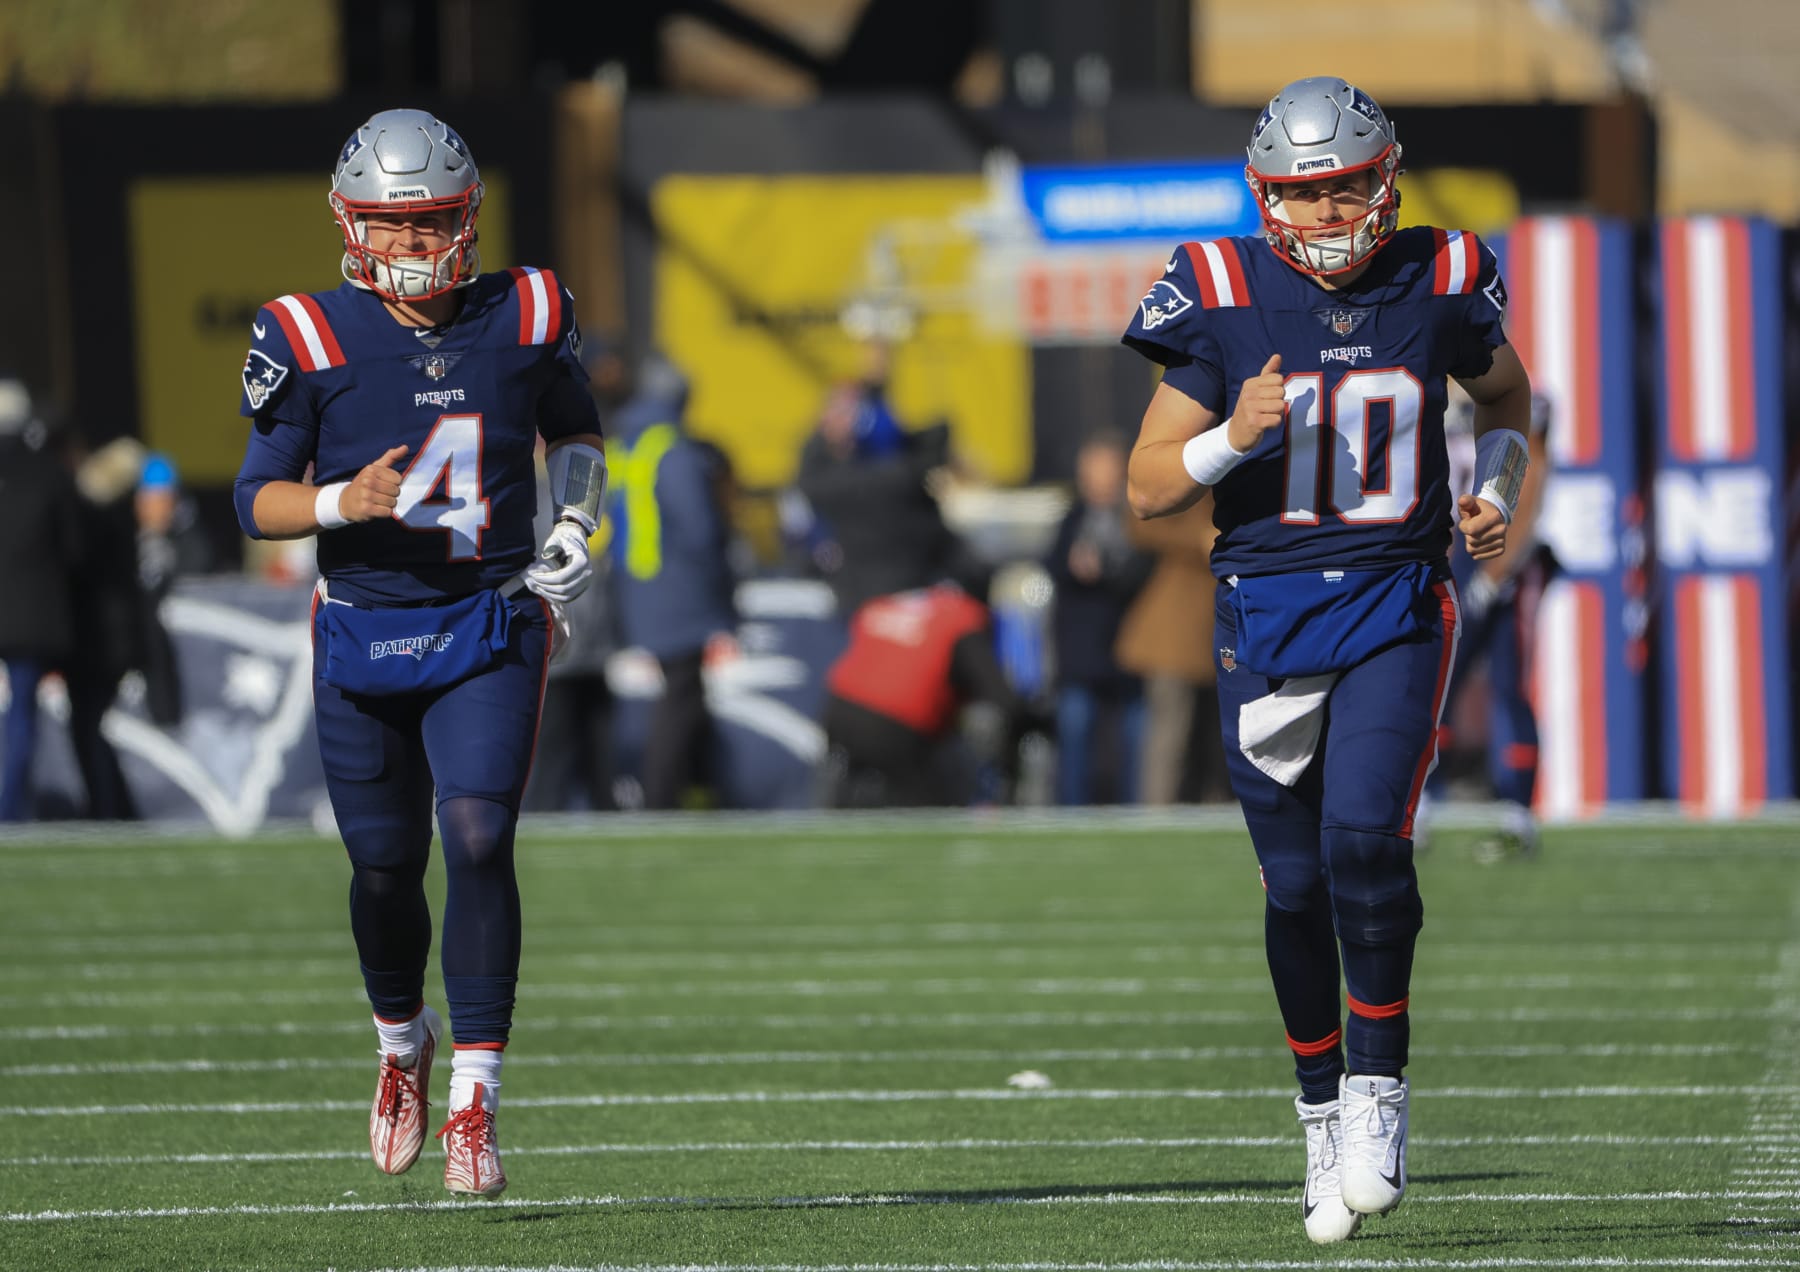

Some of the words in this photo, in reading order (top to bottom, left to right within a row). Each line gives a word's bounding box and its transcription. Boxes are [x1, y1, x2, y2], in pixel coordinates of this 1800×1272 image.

[1296, 157, 1336, 173] PATRIOTS
[388, 189, 427, 200] PATRIOTS
[1320, 345, 1373, 364] PATRIOTS
[414, 388, 465, 408] PATRIOTS
[1280, 365, 1425, 526] 10
[391, 412, 492, 563] 4
[1653, 468, 1774, 568] NE
[370, 632, 454, 660] PATRIOTS
